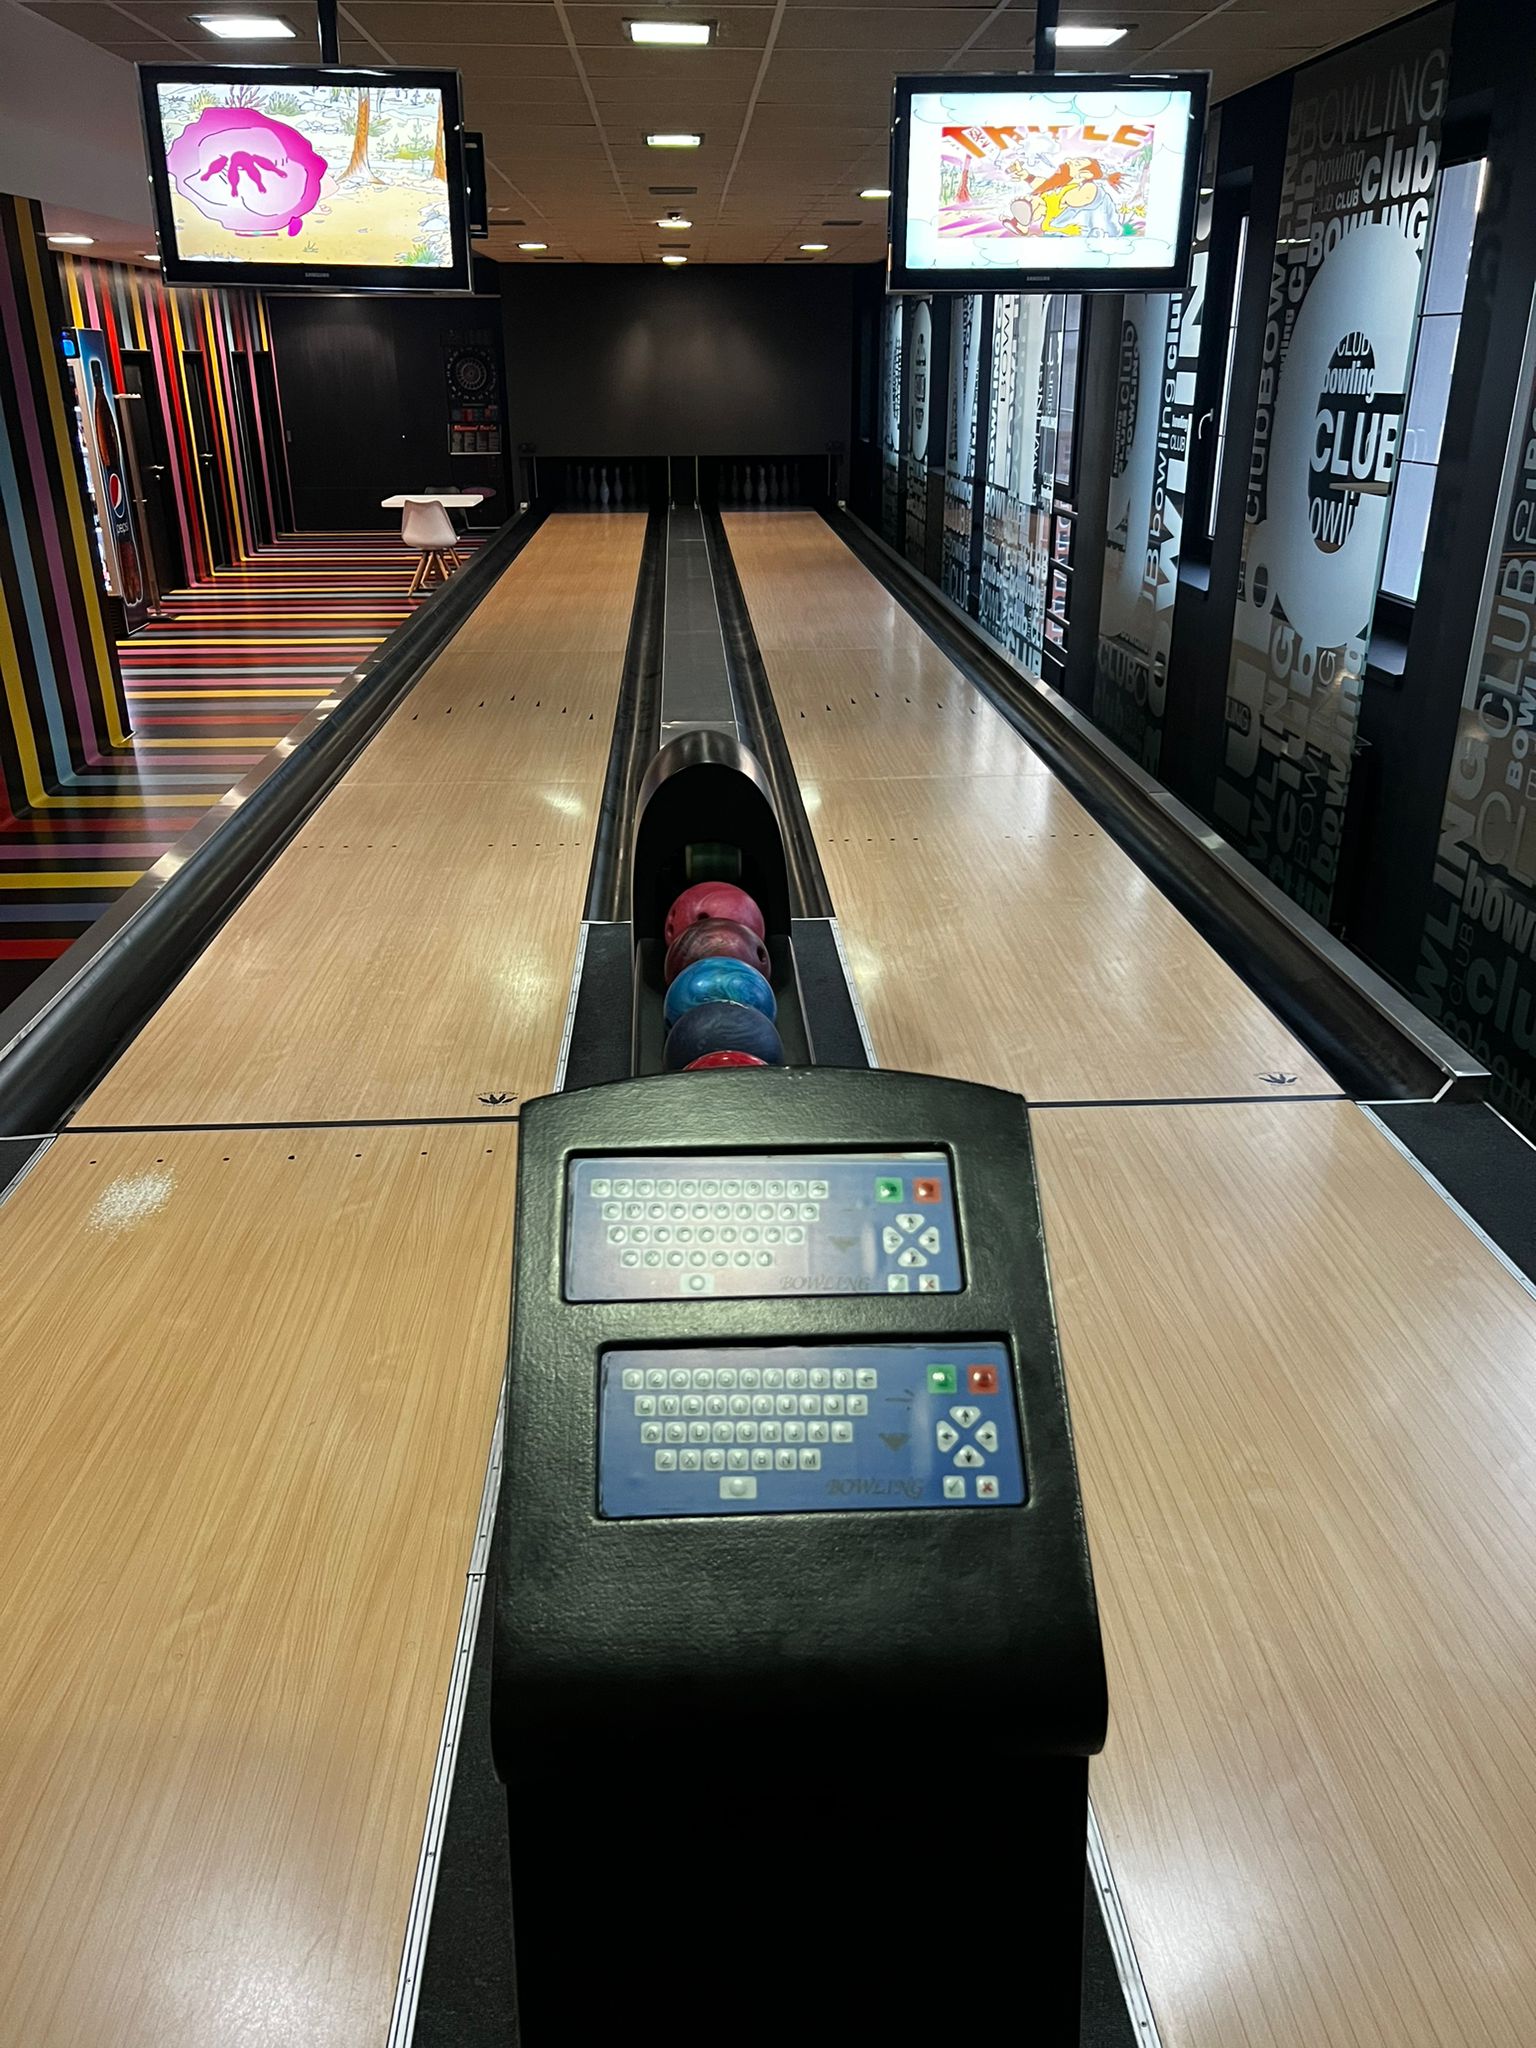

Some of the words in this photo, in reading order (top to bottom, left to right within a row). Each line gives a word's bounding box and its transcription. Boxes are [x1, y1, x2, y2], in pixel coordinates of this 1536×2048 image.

[1301, 47, 1446, 153] BOWLING
[1361, 126, 1437, 206] club
[1306, 197, 1429, 268] BOING
[1147, 377, 1179, 537] bowling
[1166, 294, 1182, 372] clu
[1310, 408, 1399, 483] CLUB
[780, 1273, 872, 1291] BOWLING
